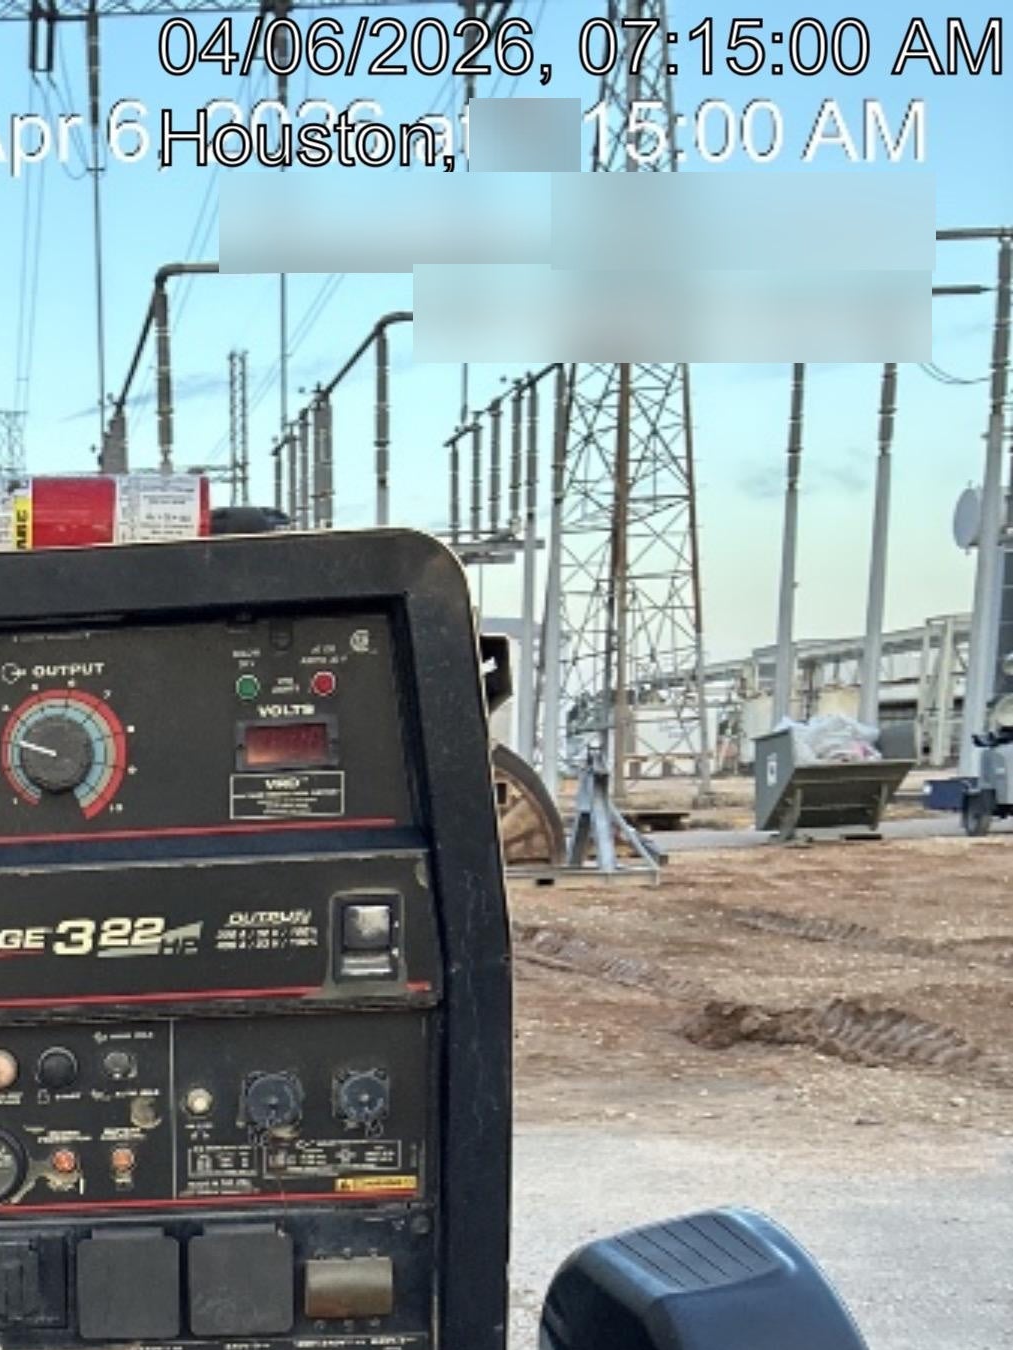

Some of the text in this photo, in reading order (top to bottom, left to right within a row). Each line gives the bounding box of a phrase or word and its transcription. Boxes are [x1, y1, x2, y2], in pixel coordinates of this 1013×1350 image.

[31, 661, 105, 678] OUTPUT
[257, 704, 315, 718] VOLTS
[52, 916, 166, 955] 322
